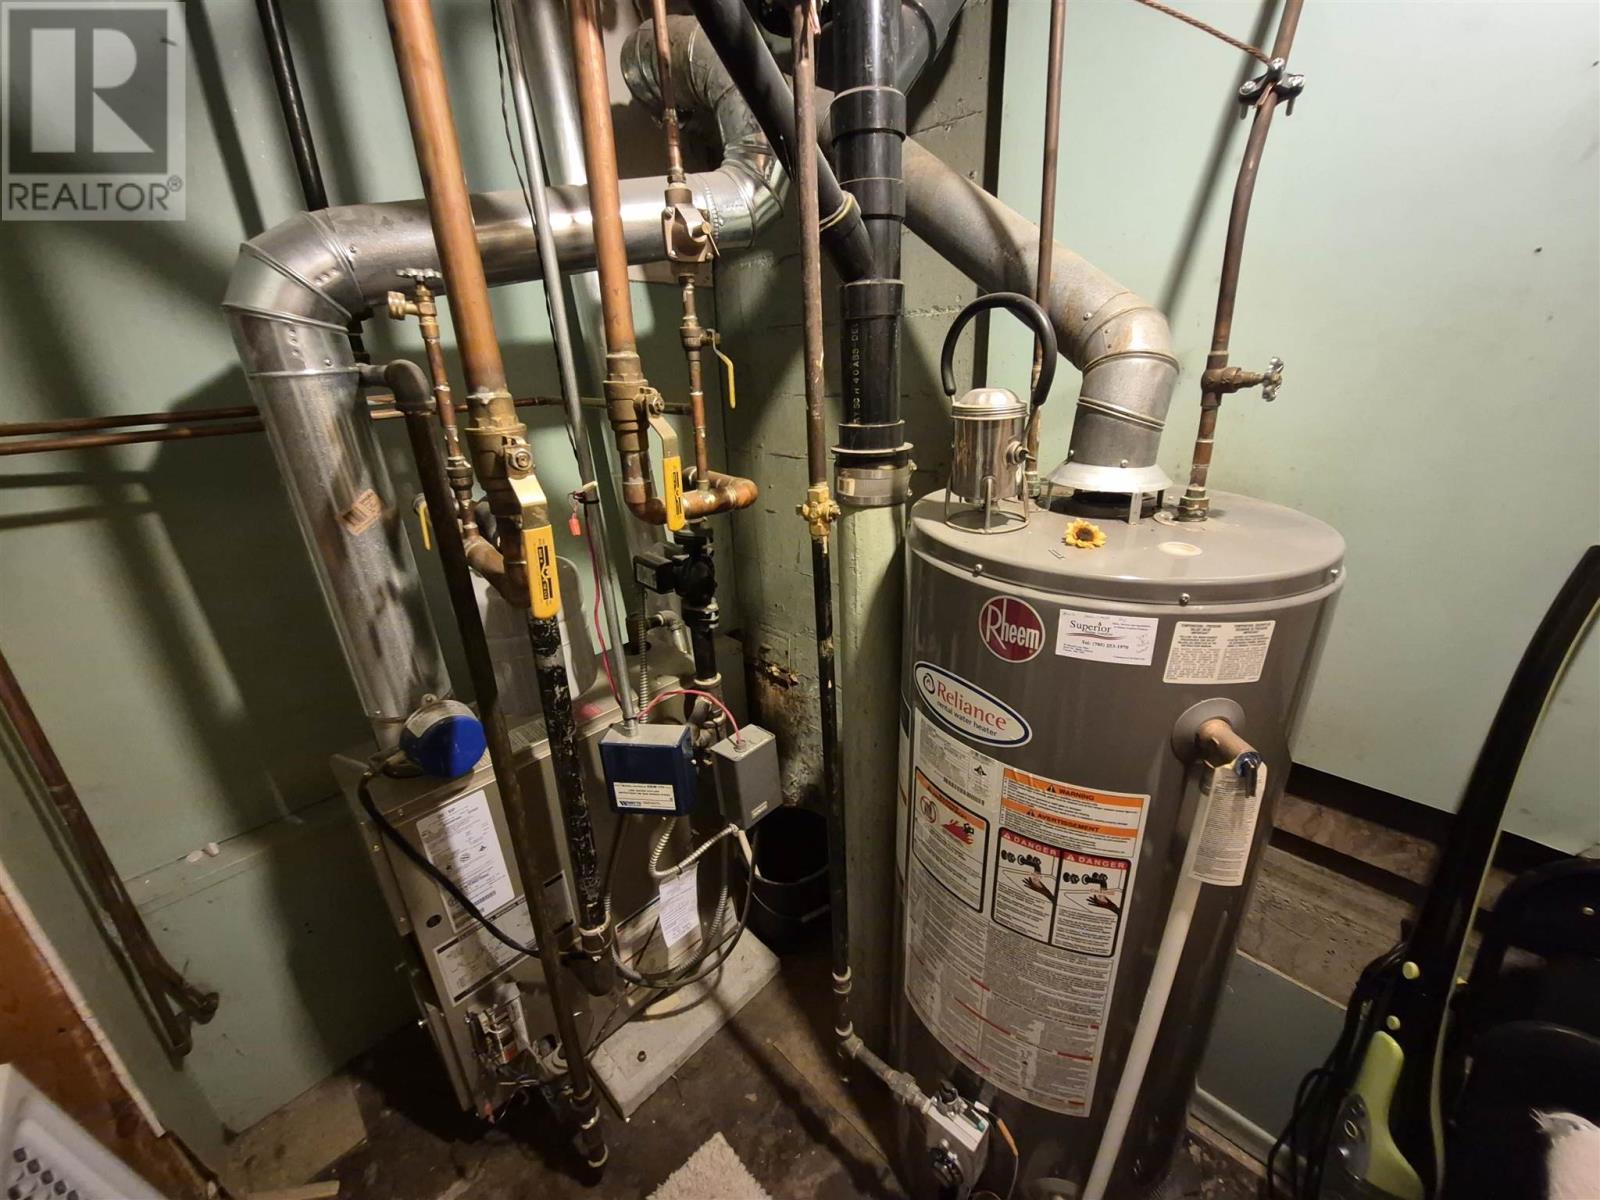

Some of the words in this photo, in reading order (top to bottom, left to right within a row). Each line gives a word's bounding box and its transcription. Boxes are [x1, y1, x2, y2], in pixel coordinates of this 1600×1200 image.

[986, 598, 1040, 650] Rheem
[1069, 620, 1112, 633] Superior
[936, 681, 1007, 731] Reliance
[954, 711, 972, 724] water
[973, 720, 998, 737] heater
[1059, 787, 1095, 801] WARNING
[1013, 837, 1058, 856] DANGER
[1078, 856, 1126, 870] DANGER
